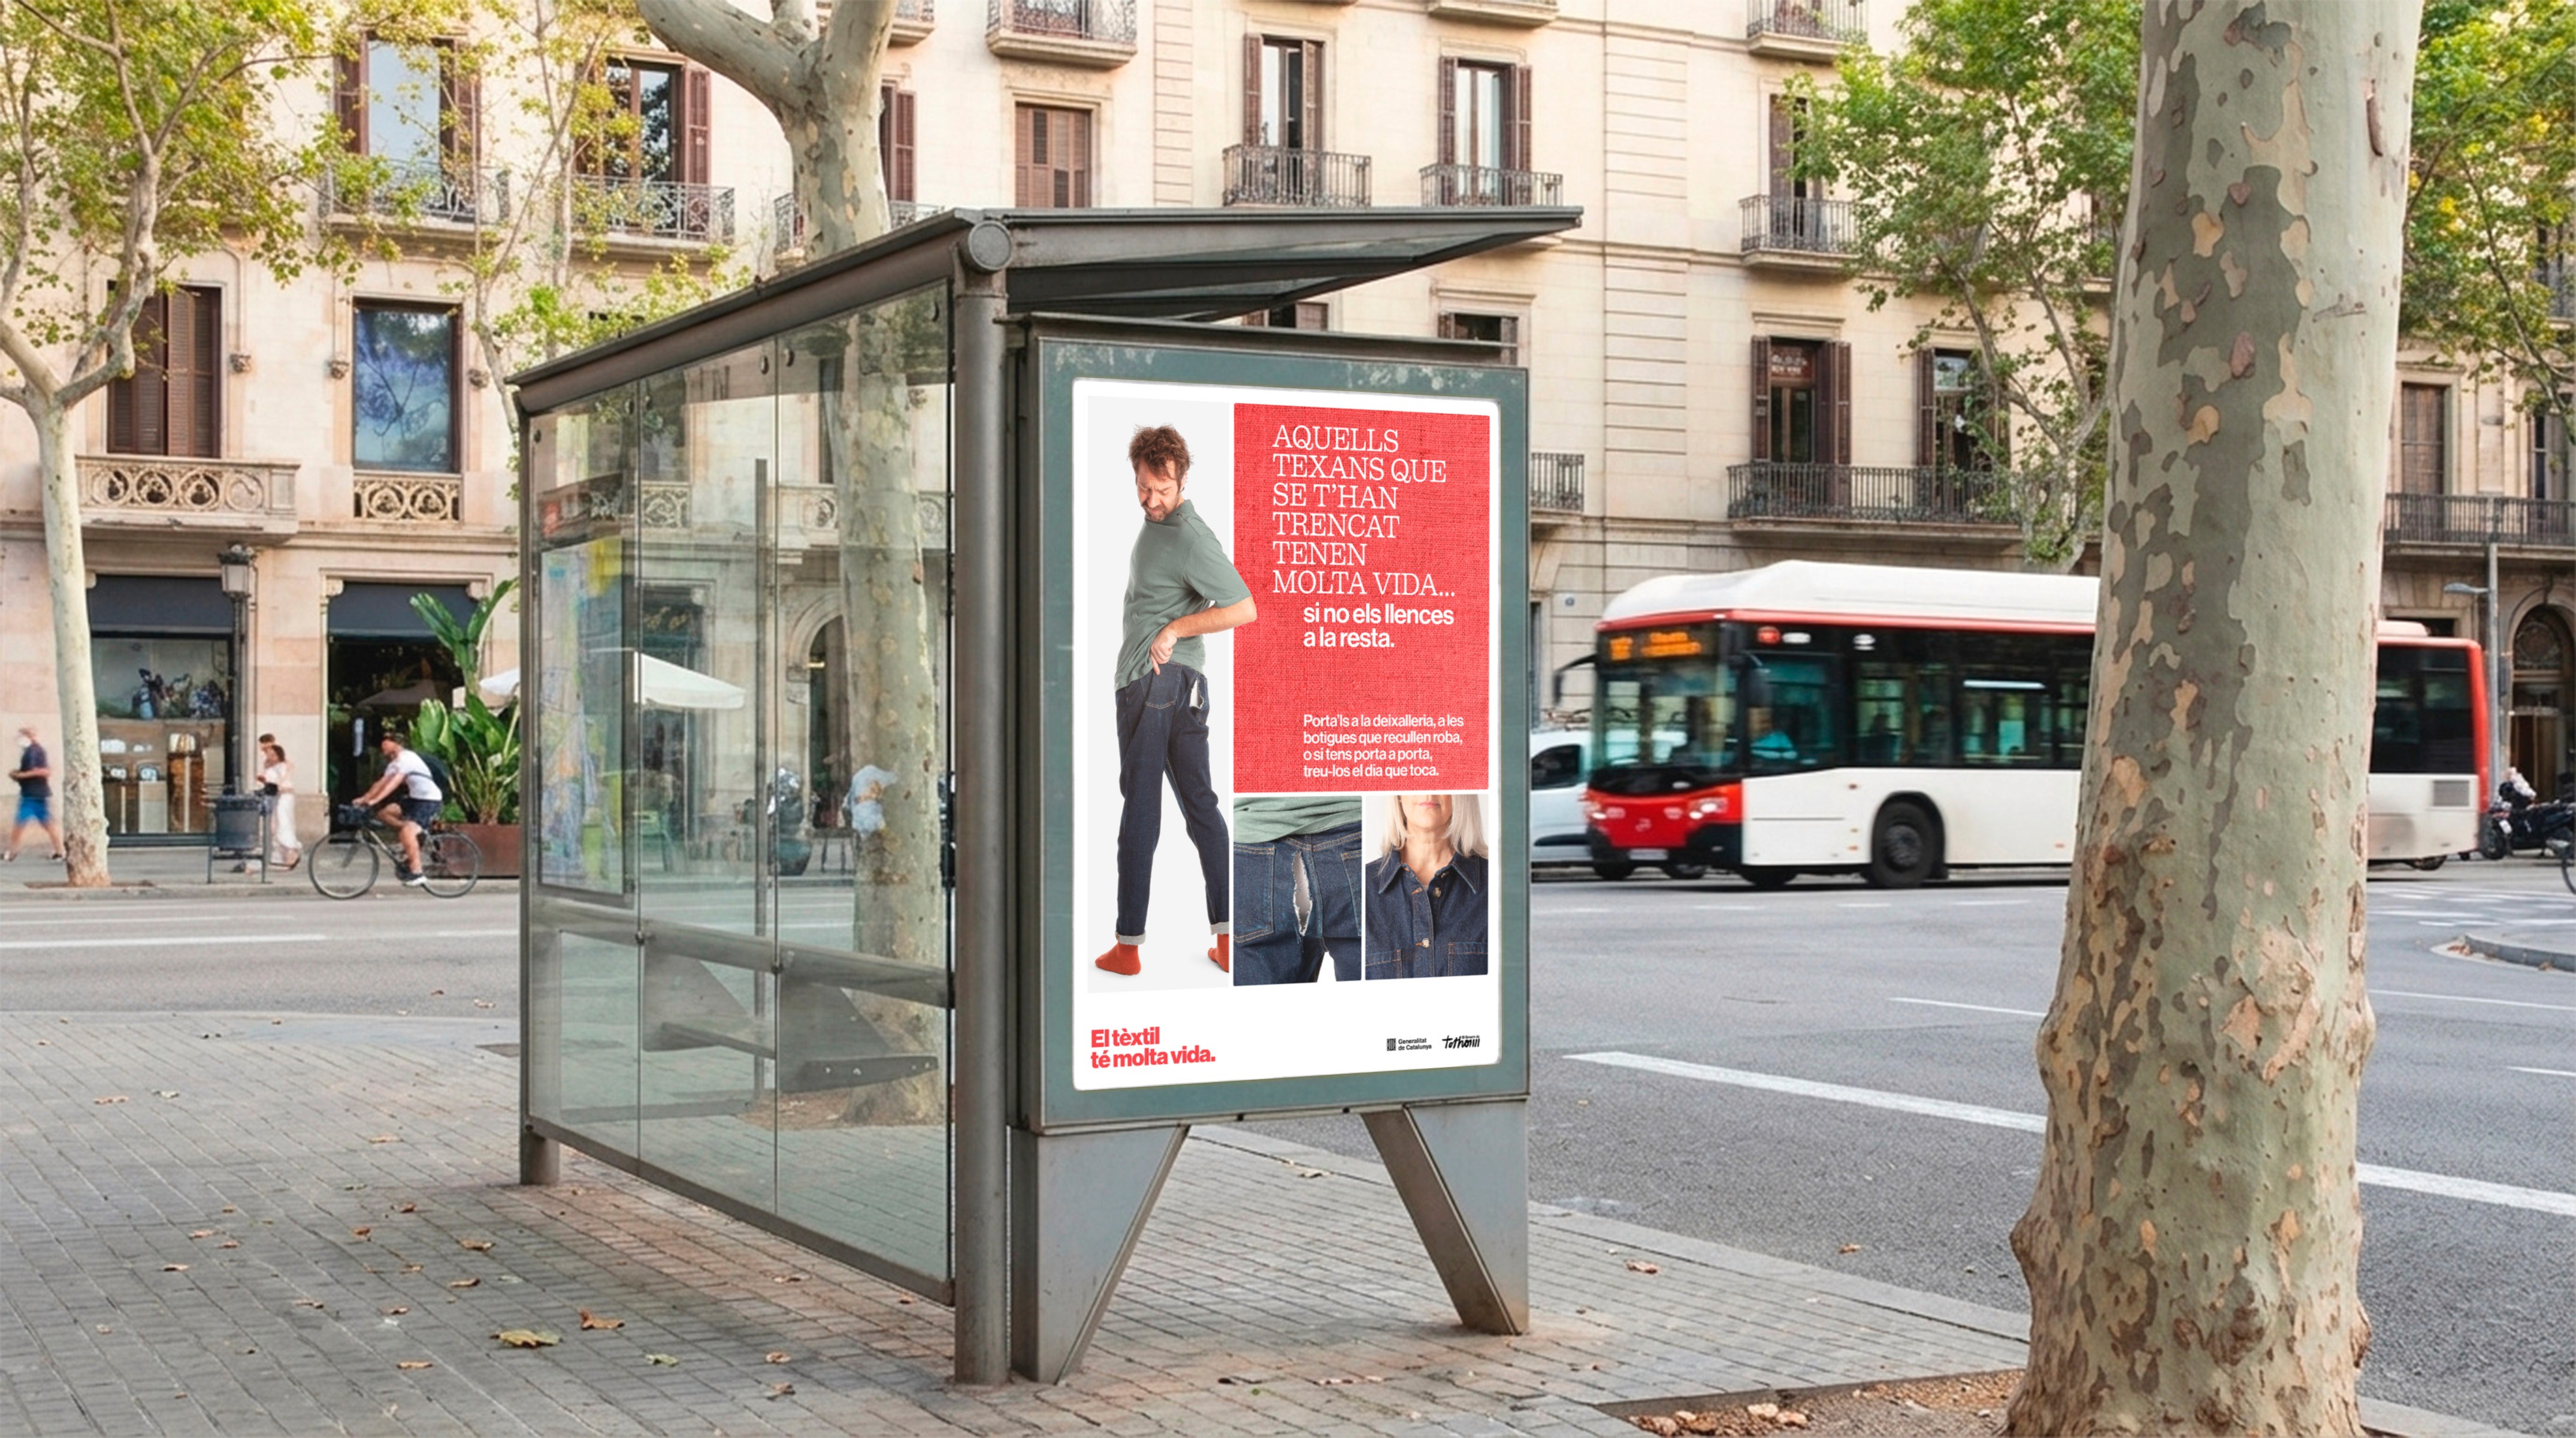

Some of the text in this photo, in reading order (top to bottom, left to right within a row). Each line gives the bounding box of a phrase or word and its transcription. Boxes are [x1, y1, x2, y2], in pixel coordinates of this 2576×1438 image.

[1272, 425, 1398, 452] AQUELLS
[1272, 454, 1446, 483] TEXANS QUE
[1273, 482, 1398, 509] SE T’HAN
[1272, 512, 1399, 538] TRENCAT
[1272, 542, 1367, 565] TENEN
[1272, 570, 1455, 597] MOLTA VIDA...
[1304, 602, 1454, 624] si no els llences
[1304, 627, 1395, 648] a la resta.
[1304, 714, 1464, 729] Porta’ls a la deixalleria, a les
[1304, 731, 1462, 746] botigues que recullen roba,
[1304, 748, 1432, 762] o si tens porta a porta,
[1304, 765, 1438, 778] treu-los el dia que toca.
[1092, 1026, 1160, 1047] El tèxtil
[1091, 1045, 1216, 1068] té molta vida.
